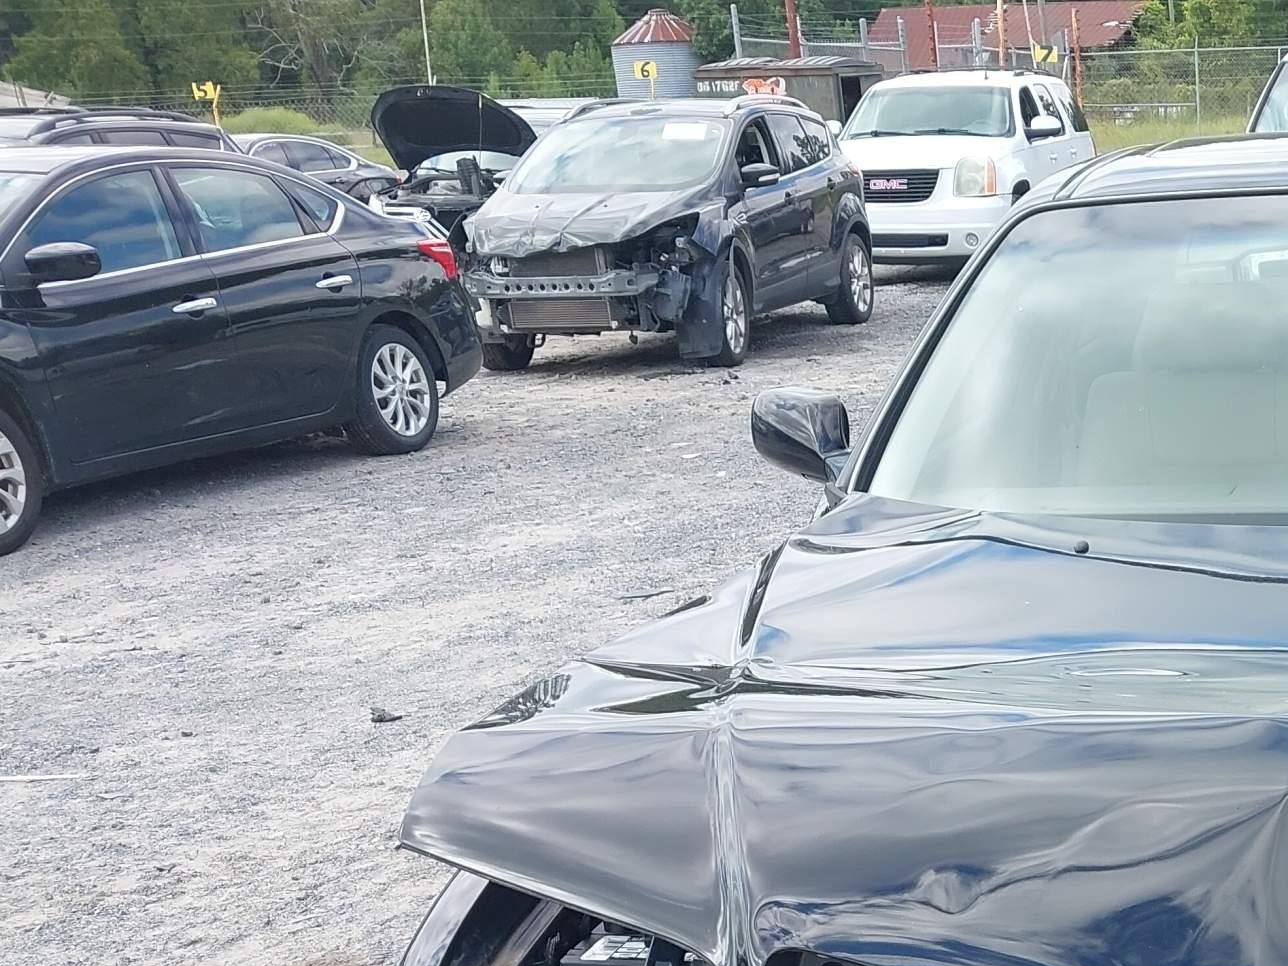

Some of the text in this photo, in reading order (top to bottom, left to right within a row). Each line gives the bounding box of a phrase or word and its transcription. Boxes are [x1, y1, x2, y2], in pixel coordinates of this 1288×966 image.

[1039, 45, 1054, 63] 7
[640, 61, 651, 78] 6
[194, 80, 209, 99] 5
[869, 178, 909, 190] GMC
